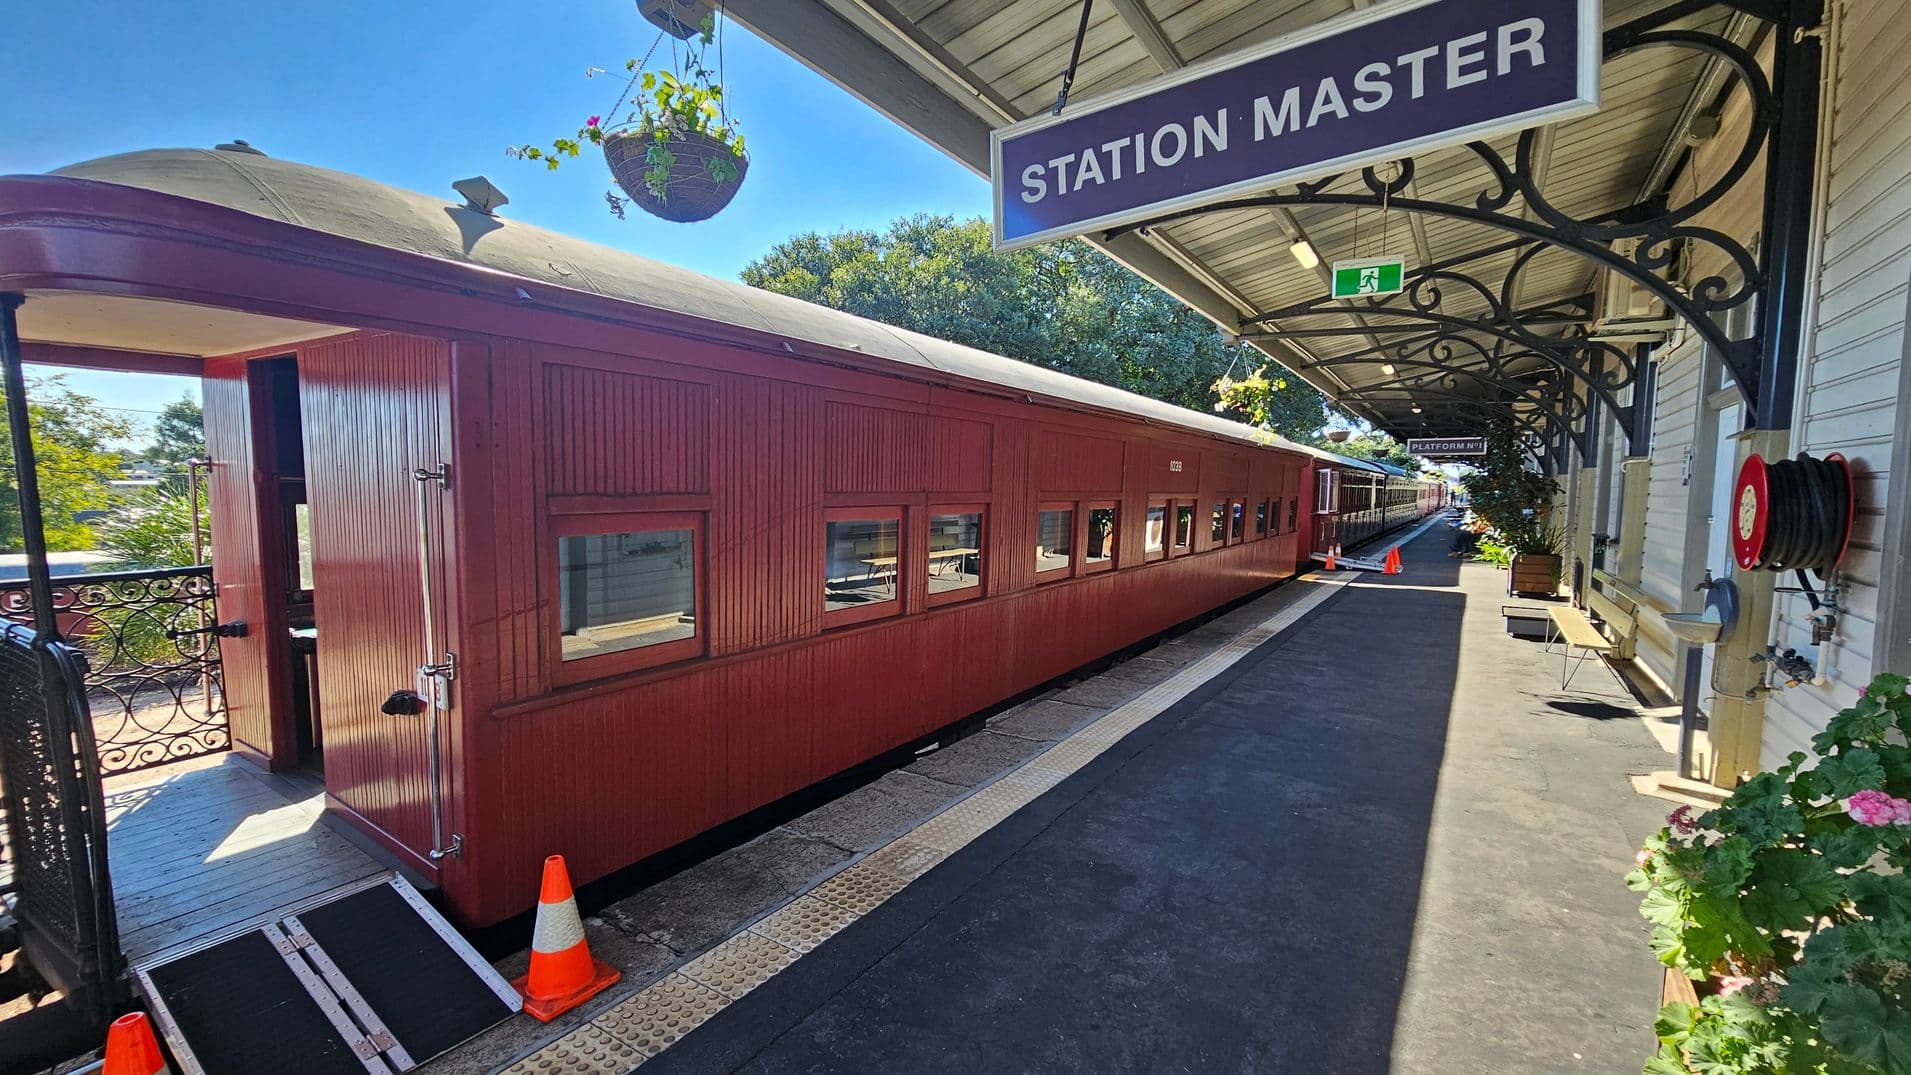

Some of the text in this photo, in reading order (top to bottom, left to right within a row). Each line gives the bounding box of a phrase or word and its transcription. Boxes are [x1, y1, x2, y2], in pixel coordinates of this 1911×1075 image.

[1020, 17, 1546, 203] STATION MASTER
[1411, 442, 1465, 450] PLATFORM
